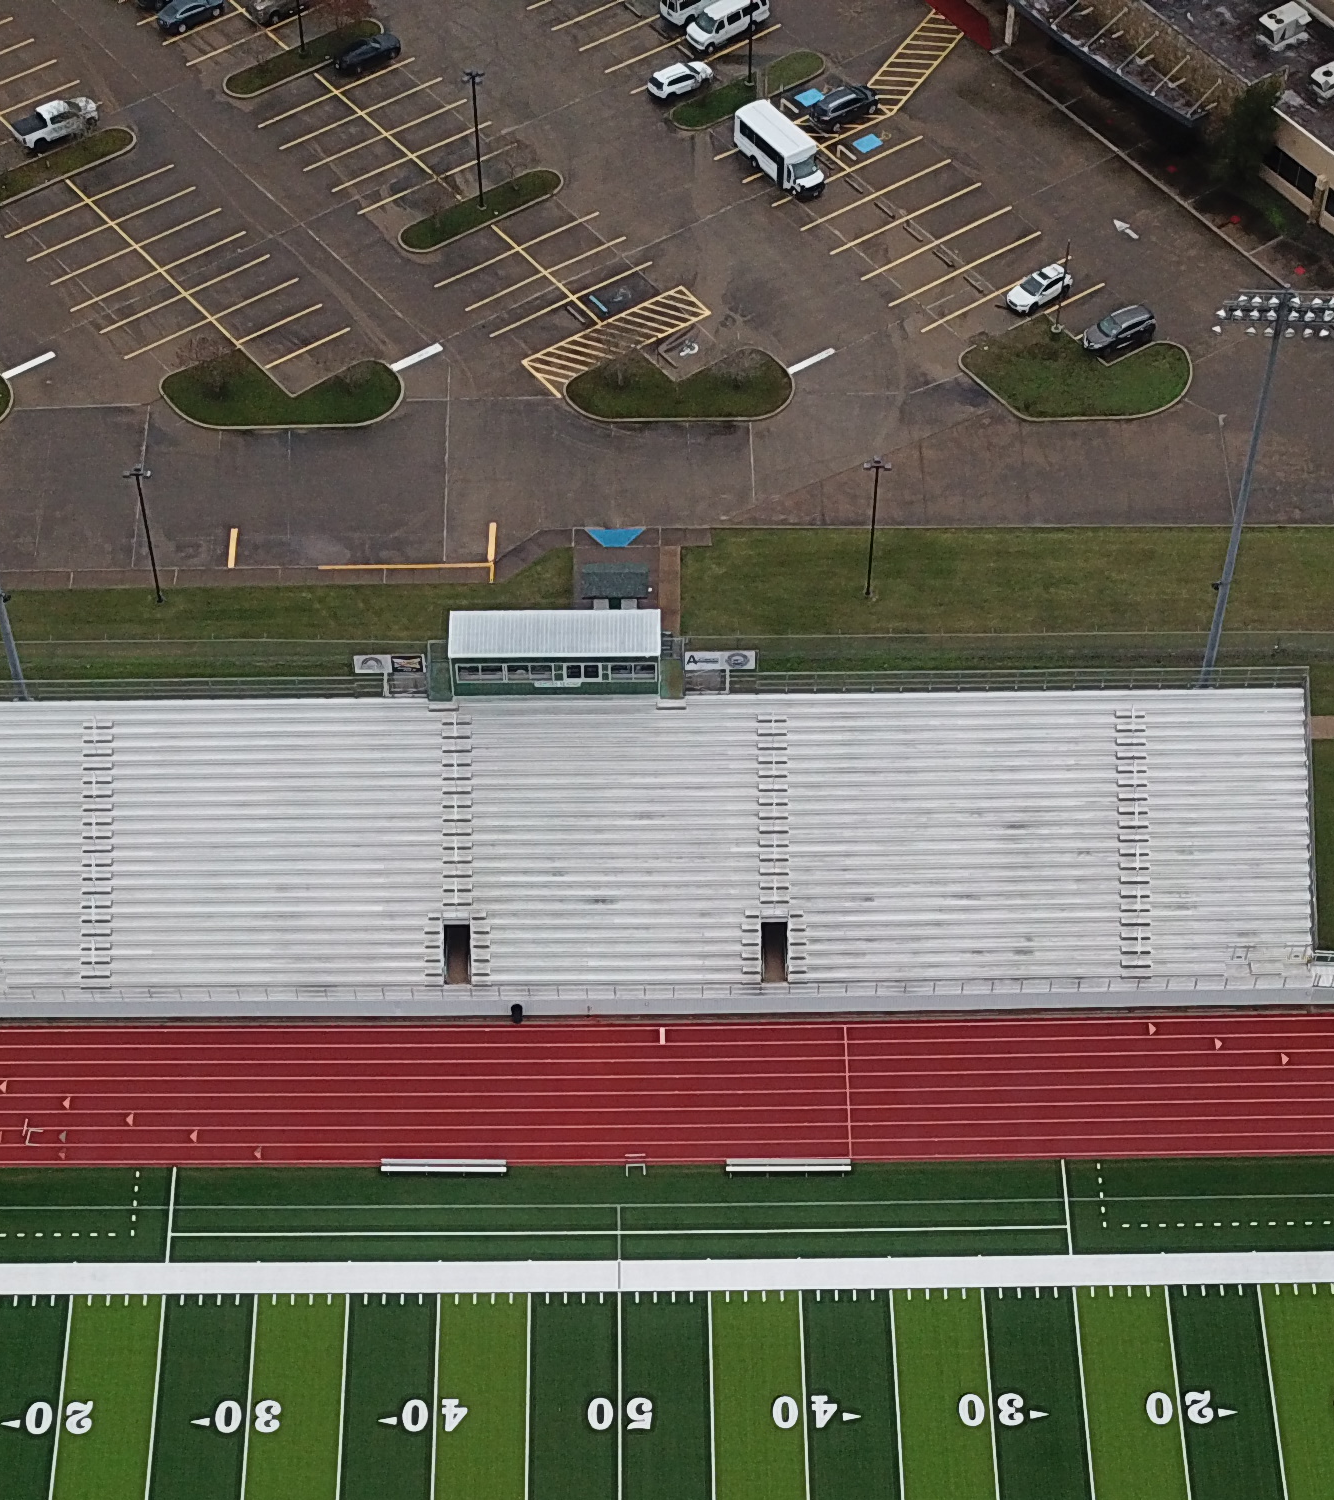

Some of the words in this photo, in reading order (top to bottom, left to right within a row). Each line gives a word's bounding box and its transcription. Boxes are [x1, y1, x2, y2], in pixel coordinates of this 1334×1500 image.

[25, 1402, 94, 1435] 20
[214, 1401, 282, 1434] 30
[401, 1399, 468, 1432] 40
[587, 1398, 653, 1431] 50
[772, 1395, 837, 1429] 40
[958, 1394, 1024, 1427] 30
[1145, 1391, 1214, 1425] 20
